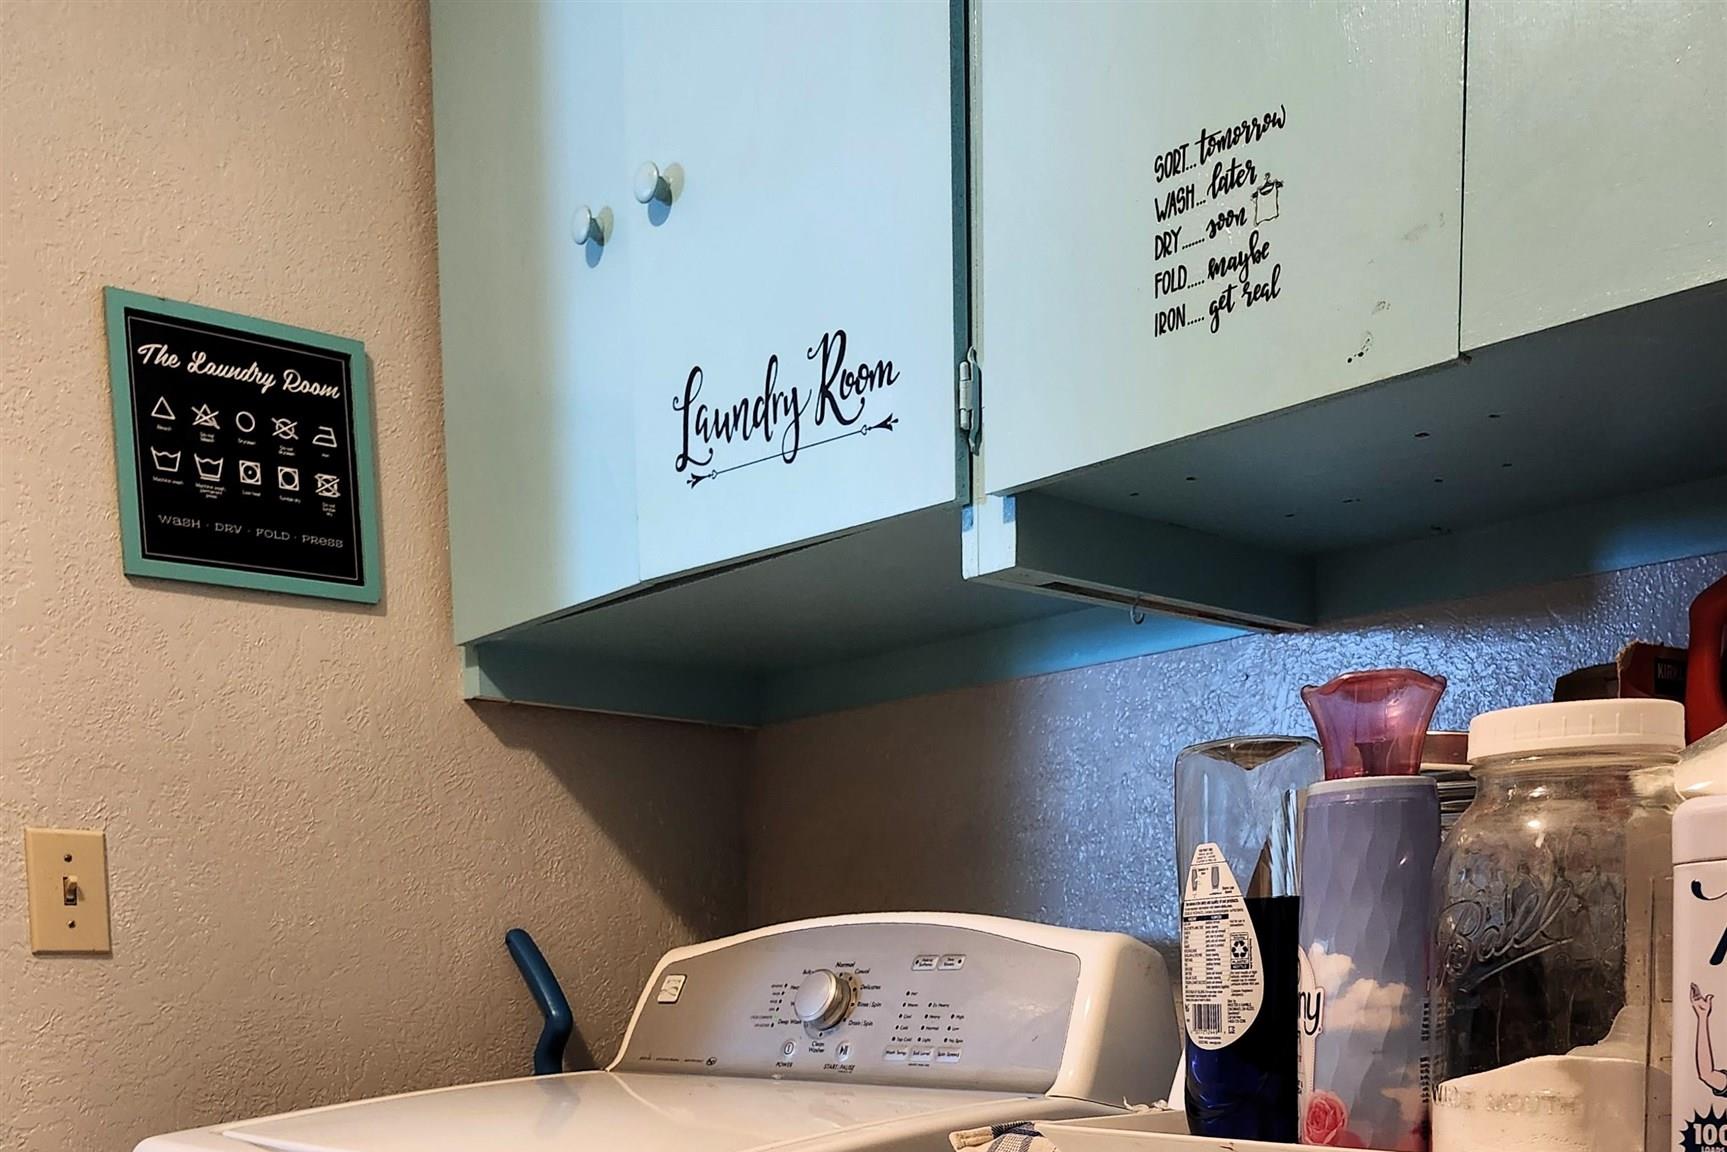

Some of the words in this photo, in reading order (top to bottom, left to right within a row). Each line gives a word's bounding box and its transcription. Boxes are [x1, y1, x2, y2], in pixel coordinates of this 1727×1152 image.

[1195, 104, 1287, 165] tomorrow
[1207, 157, 1258, 200] later
[1206, 207, 1248, 240] soon
[1208, 230, 1270, 284] maybe
[1209, 284, 1238, 334] get
[1241, 264, 1281, 307] real
[137, 343, 181, 369] The
[187, 350, 276, 394] Laundry
[282, 369, 341, 399] Room
[672, 354, 813, 472] Laundry
[807, 329, 900, 426] Room
[255, 528, 291, 541] FOLD
